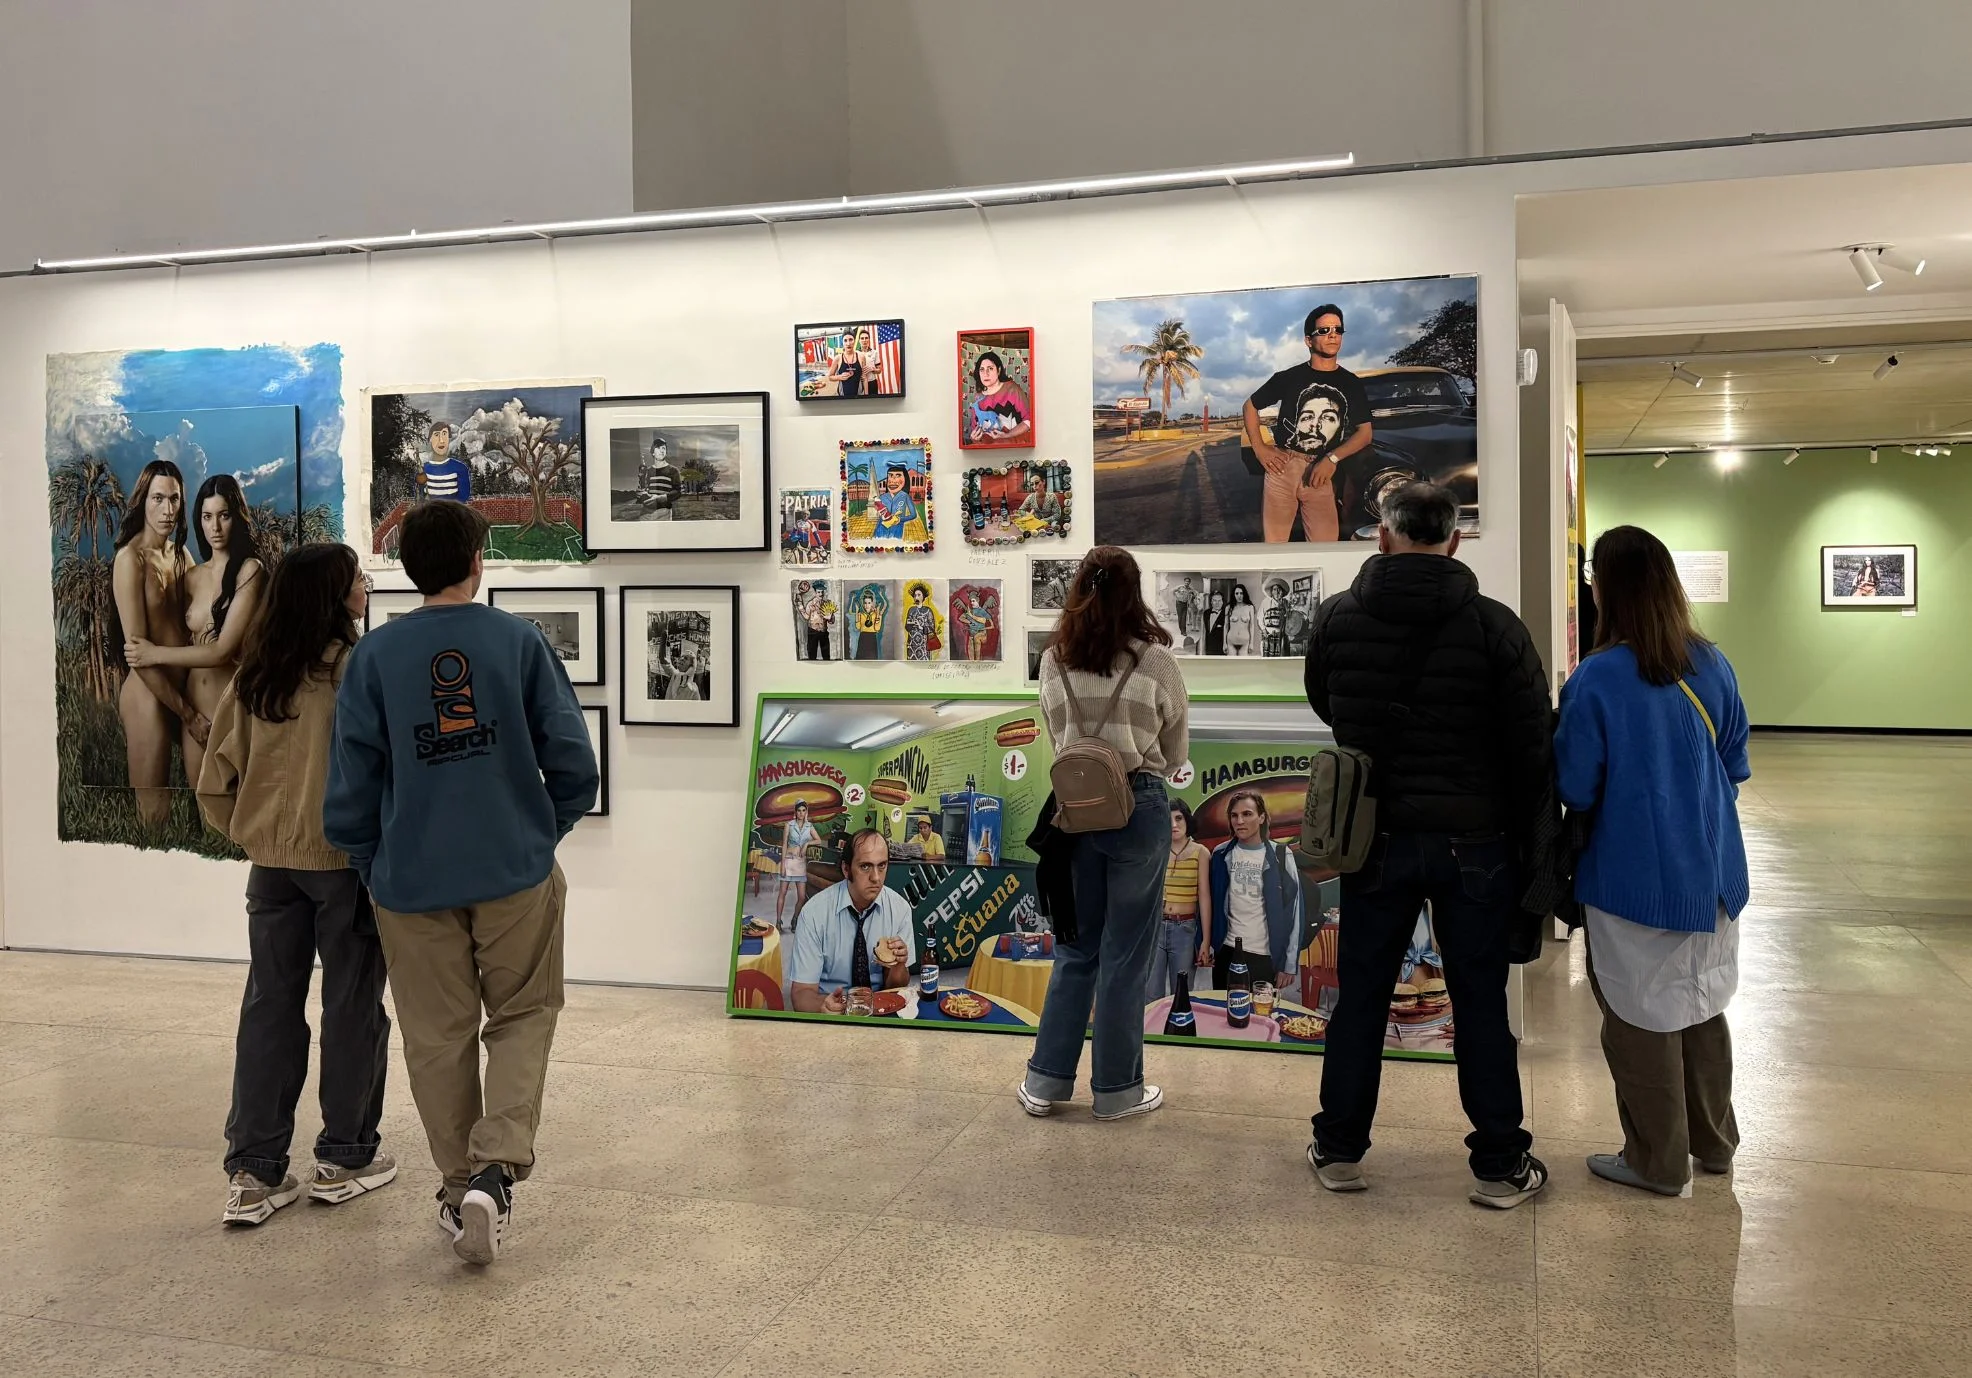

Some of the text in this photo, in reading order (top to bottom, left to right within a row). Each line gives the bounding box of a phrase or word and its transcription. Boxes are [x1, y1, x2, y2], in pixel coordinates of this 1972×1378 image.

[785, 494, 829, 512] PATRIA
[413, 722, 497, 760] Search
[757, 759, 847, 788] HAMBURGUESA
[1202, 755, 1314, 795] HAMBURG
[922, 867, 981, 930] PEPSI
